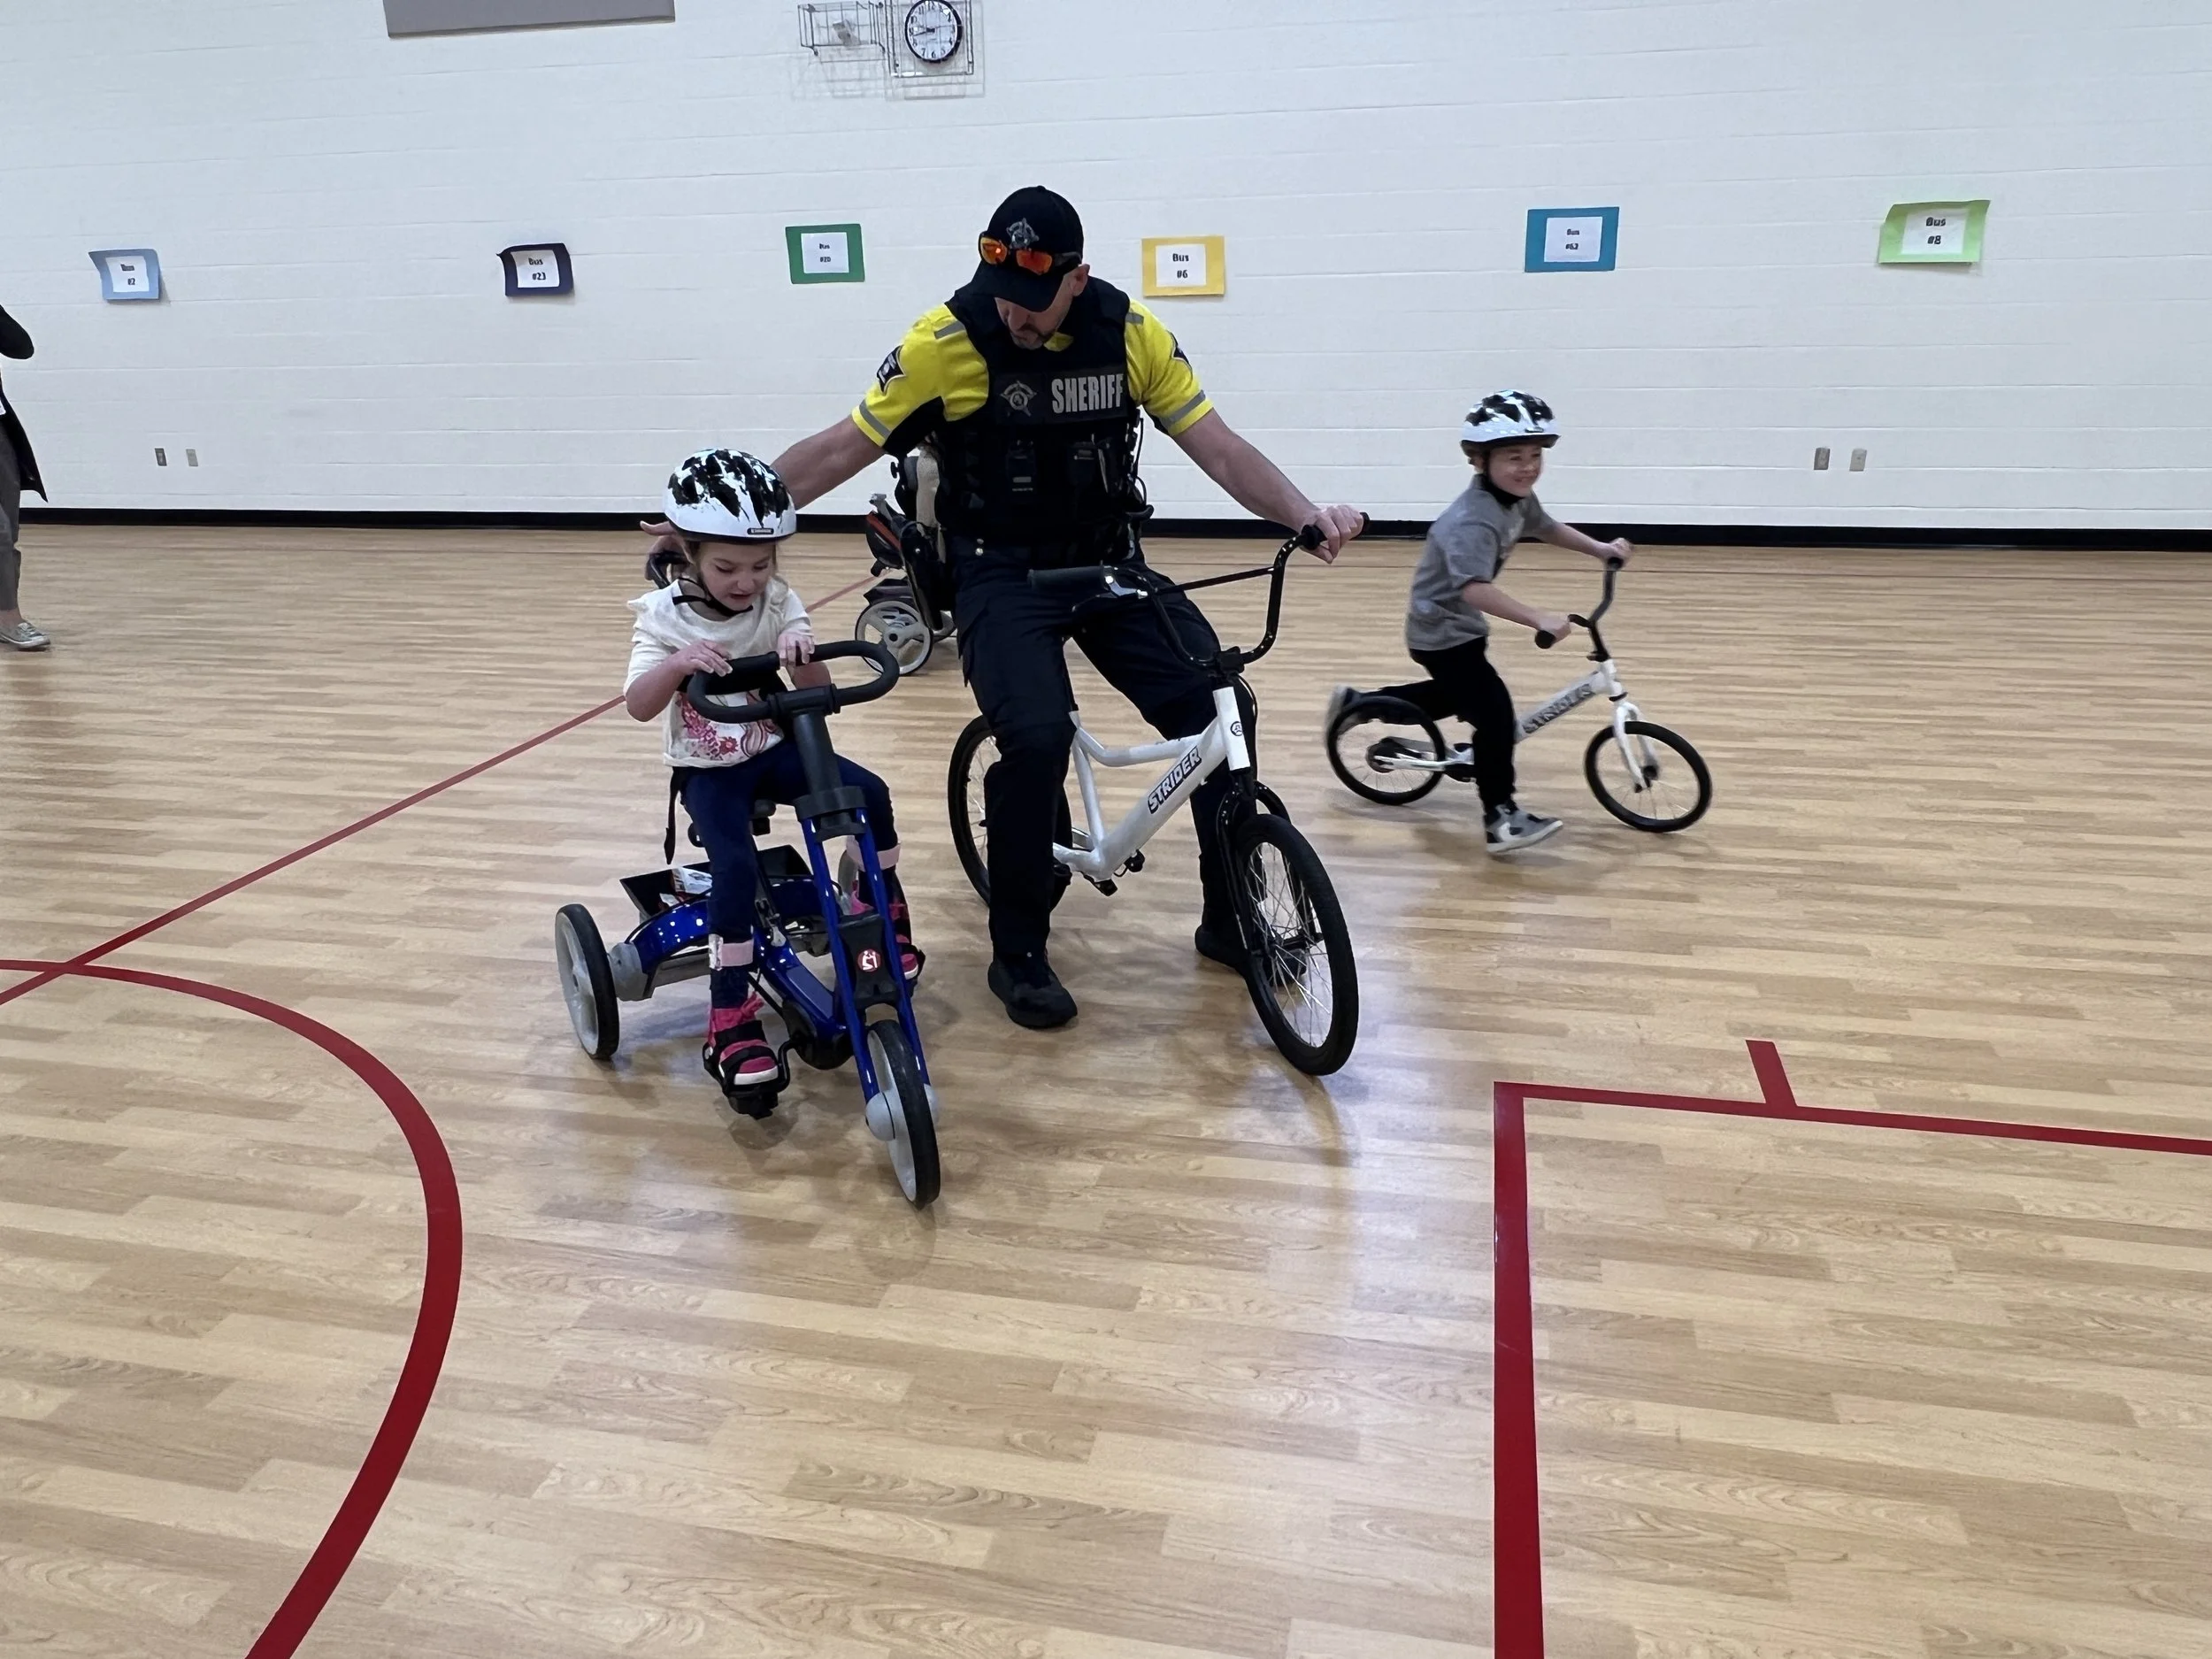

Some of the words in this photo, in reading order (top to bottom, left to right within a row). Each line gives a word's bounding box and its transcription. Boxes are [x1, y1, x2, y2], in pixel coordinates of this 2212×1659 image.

[1925, 217, 1947, 227] Bus
[1172, 253, 1189, 262] Bus
[1177, 269, 1188, 279] #6
[1051, 373, 1124, 414] SHERIFF
[1148, 746, 1202, 815] STRIDER
